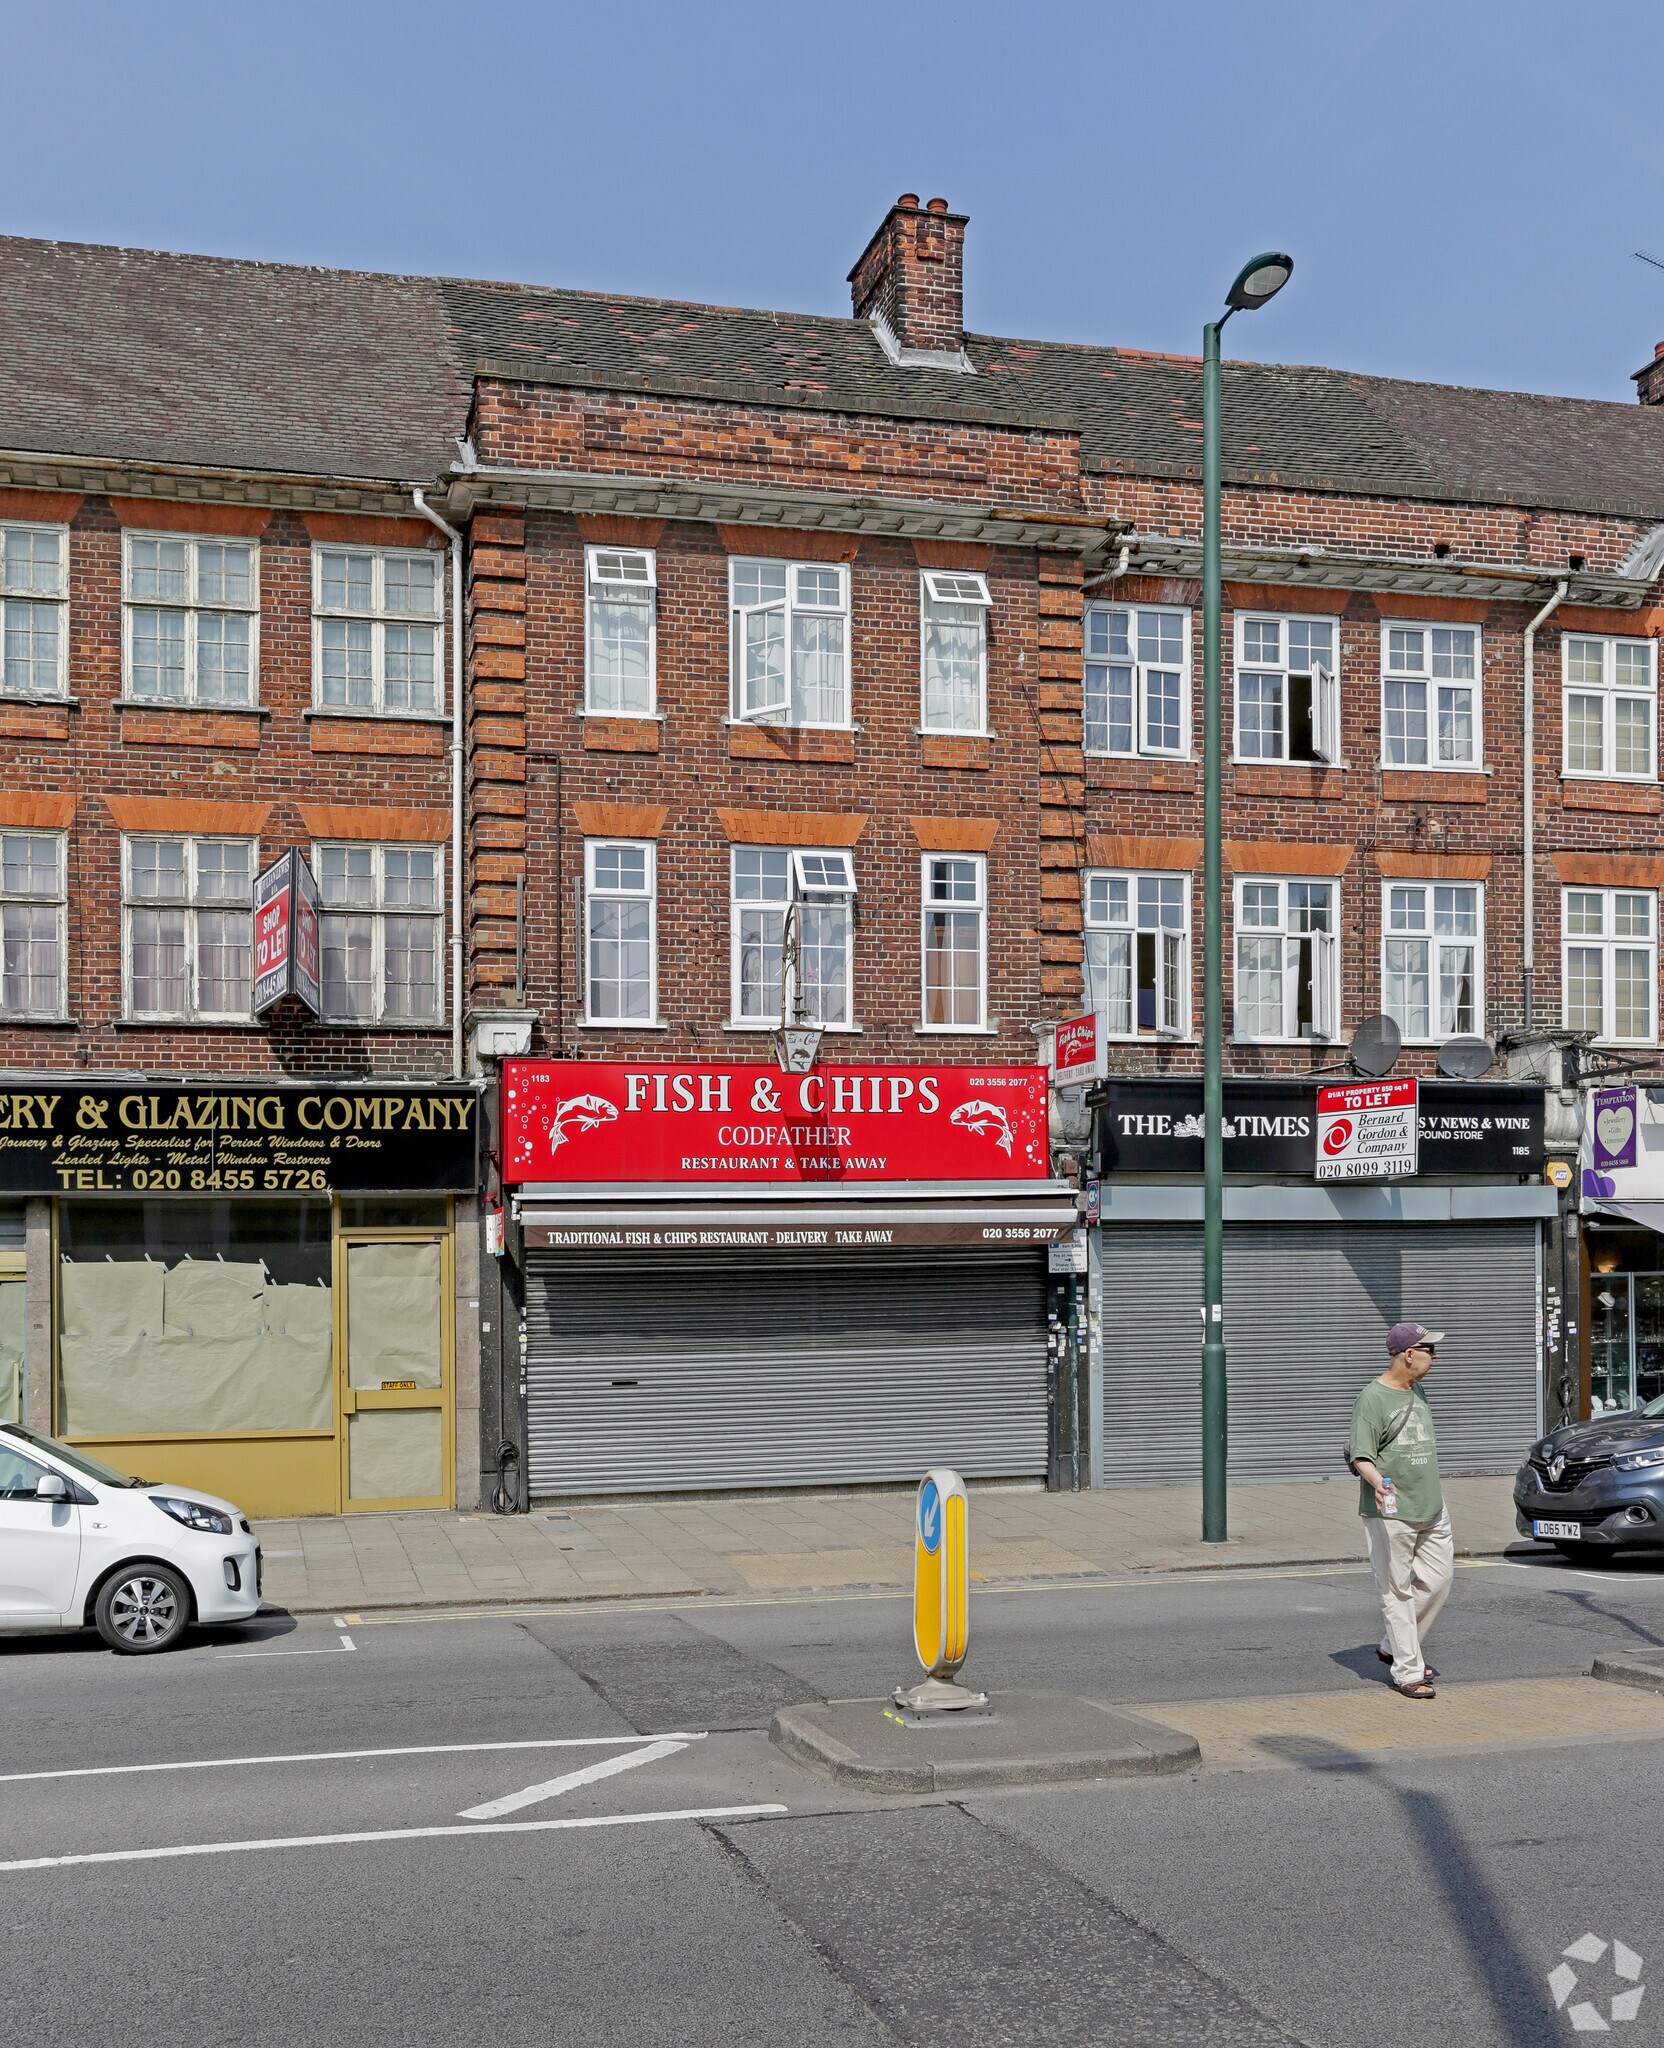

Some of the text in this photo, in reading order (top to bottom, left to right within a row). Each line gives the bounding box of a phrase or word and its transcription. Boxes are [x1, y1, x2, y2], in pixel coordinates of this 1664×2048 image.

[263, 905, 280, 934] SHOP
[257, 924, 287, 969] TO LET
[1059, 1029, 1071, 1047] Fish
[1072, 1027, 1076, 1039] &
[1077, 1026, 1094, 1040] Chips
[531, 1075, 550, 1083] 1183
[970, 1078, 1028, 1087] 020 3556 2077
[624, 1073, 940, 1114] FISH & CHIPS
[1346, 1087, 1380, 1096] PROPERTY
[1344, 1093, 1391, 1109] TO LET
[1596, 1094, 1635, 1107] TEMPTATION
[75, 1095, 108, 1130] &
[119, 1095, 285, 1130] GLAZING
[298, 1096, 475, 1130] COMPANY
[1358, 1112, 1404, 1126] Bernard
[1118, 1114, 1310, 1137] THE TIMES
[1418, 1117, 1530, 1129] S V NEWS & WINE
[718, 1126, 852, 1146] CODFATHER
[1357, 1126, 1408, 1140] Gordon &
[1418, 1131, 1484, 1140] POUND STORE
[0, 1134, 382, 1151] Joinery & Glazing Specialist for Period Windows & Doors
[1357, 1142, 1408, 1155] Company
[1512, 1146, 1530, 1156] 1185
[52, 1152, 103, 1165] Leaded
[107, 1153, 151, 1170] Lights
[167, 1152, 211, 1165] Metal
[216, 1152, 268, 1165] Window
[273, 1153, 332, 1165] Restorers
[681, 1157, 887, 1170] RESTAURANT & TAKE AWAY
[1319, 1159, 1411, 1178] 020 8099 3119
[1555, 1171, 1567, 1180] ADT
[56, 1169, 326, 1189] TEL: 020 8455 5726
[548, 1231, 624, 1244] TRADITIONAL
[625, 1231, 651, 1244] FISH
[653, 1232, 662, 1244] &
[664, 1231, 698, 1244] CHIPS
[700, 1231, 768, 1244] RESTAURANT
[776, 1231, 828, 1244] DELIVERY
[835, 1231, 863, 1243] TAKE
[864, 1230, 893, 1243] AWAY
[982, 1228, 1059, 1238] 020 3556 2077
[1411, 1457, 1428, 1465] 2010
[1539, 1523, 1579, 1536] LO65 TWZ
